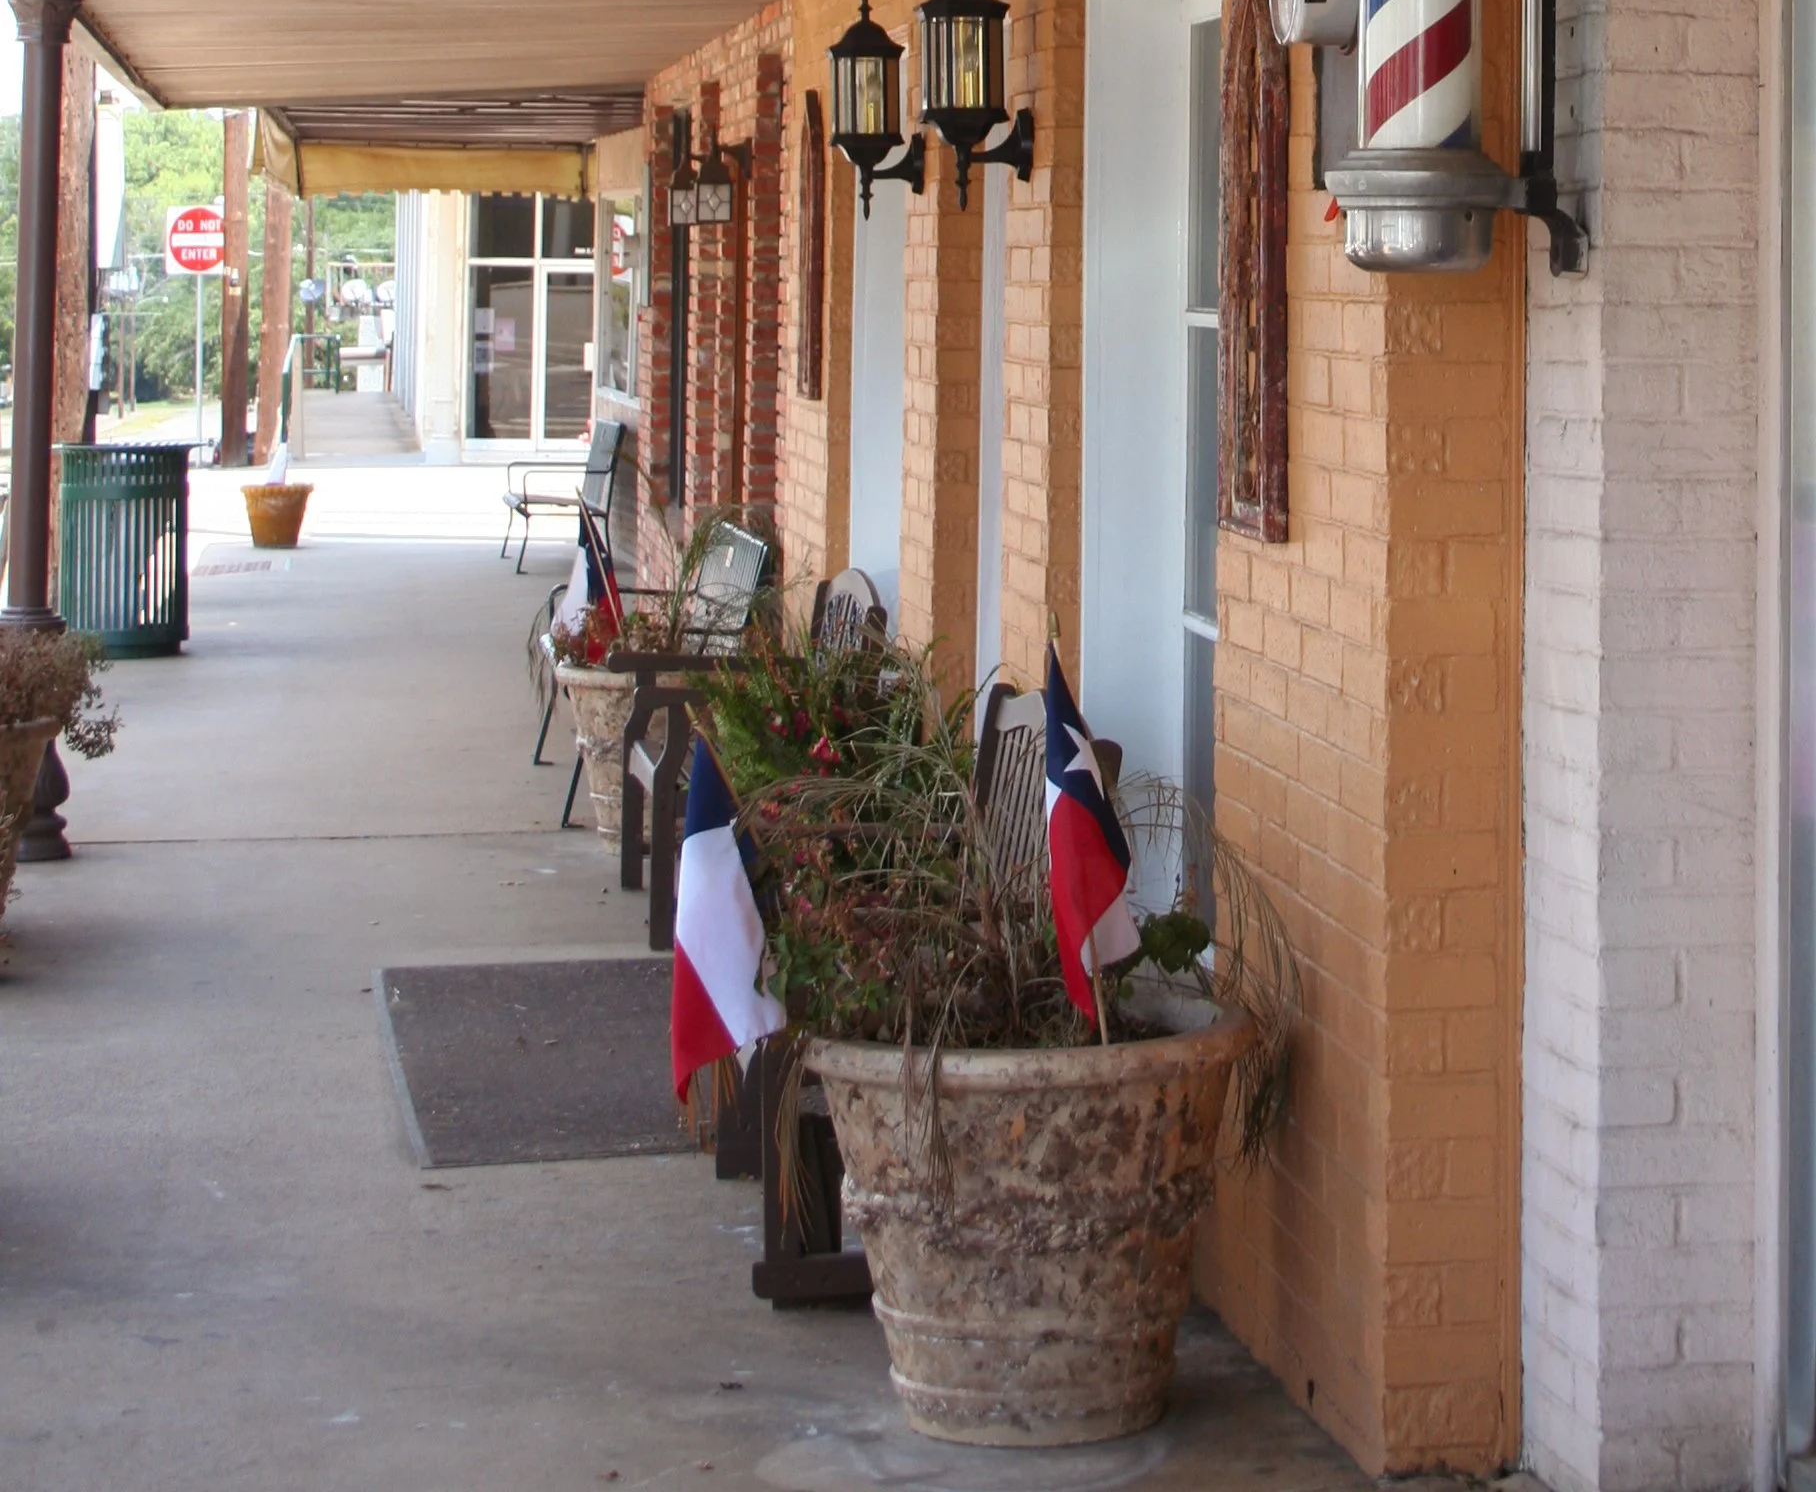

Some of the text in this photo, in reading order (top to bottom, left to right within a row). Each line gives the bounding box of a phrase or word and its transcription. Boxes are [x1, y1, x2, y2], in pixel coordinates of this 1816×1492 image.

[177, 219, 221, 231] DO NOT
[181, 248, 217, 261] ENTER
